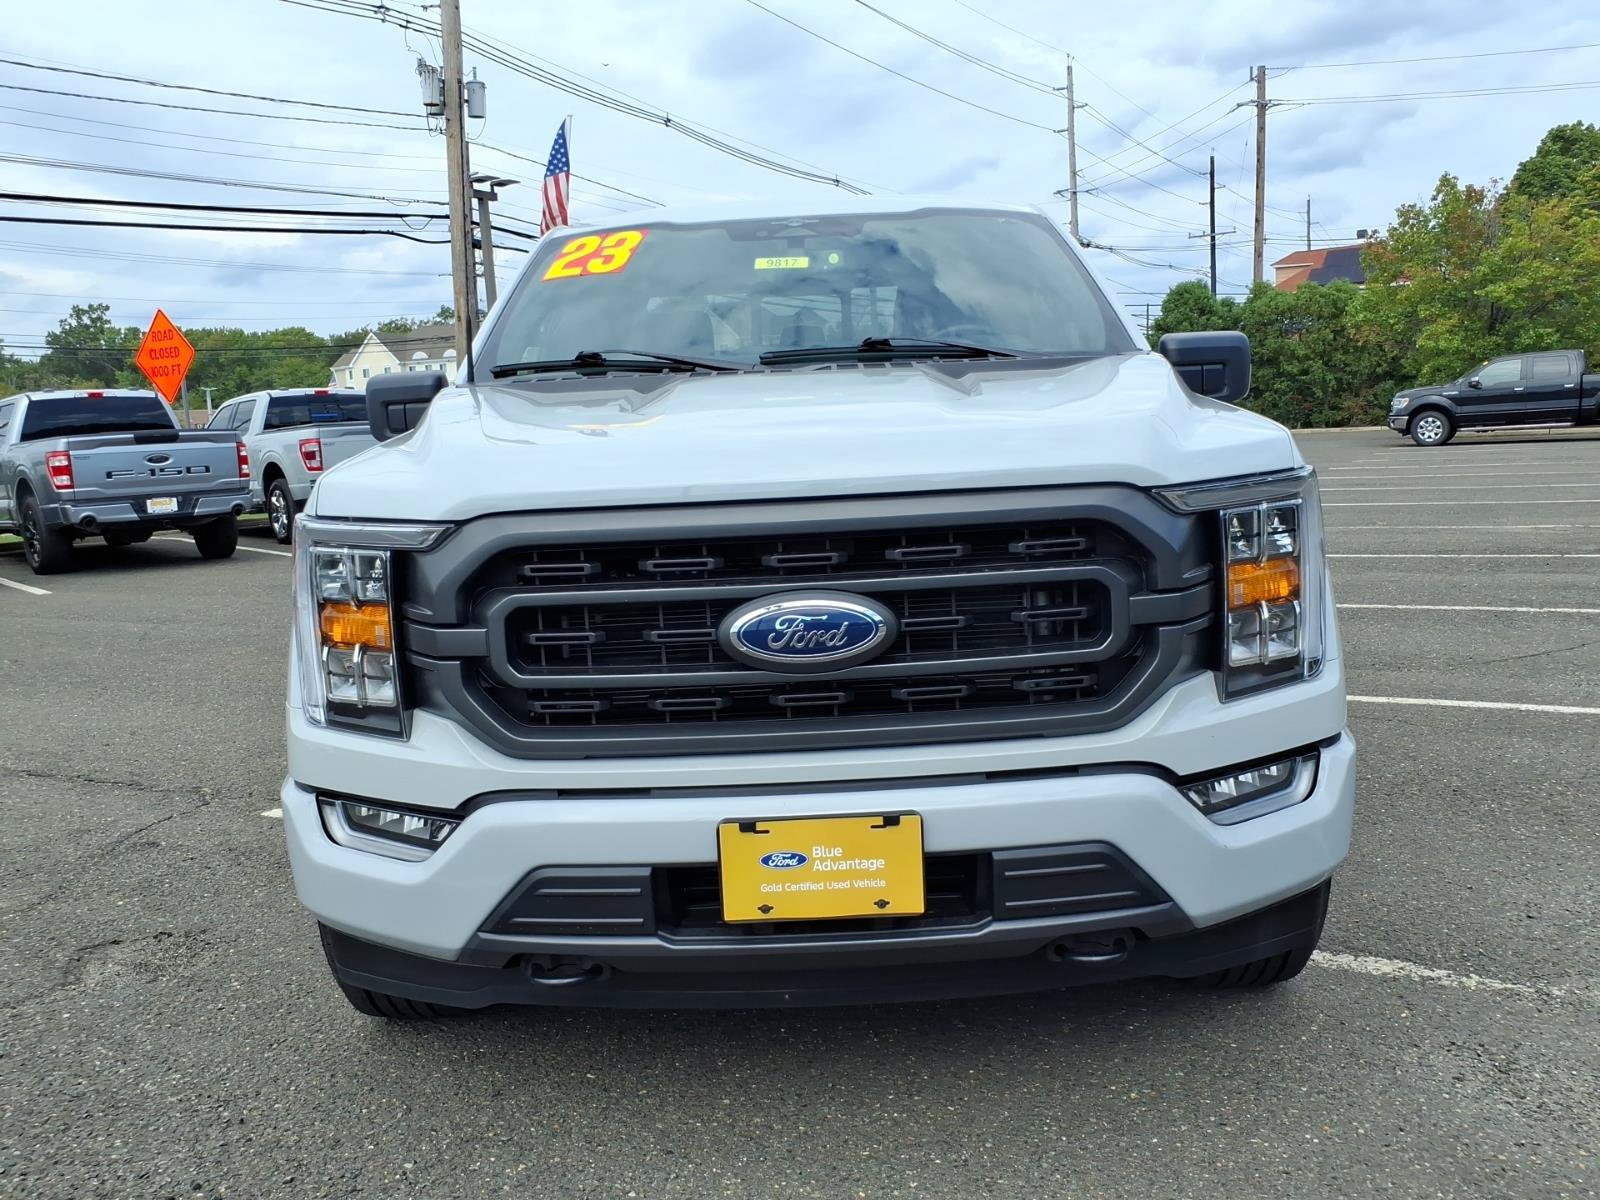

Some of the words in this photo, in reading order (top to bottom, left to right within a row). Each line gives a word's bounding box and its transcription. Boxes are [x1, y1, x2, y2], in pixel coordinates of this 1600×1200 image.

[543, 230, 643, 280] 23
[766, 258, 798, 268] 9817
[151, 329, 174, 342] ROAD
[149, 346, 180, 361] CLOSED
[151, 365, 169, 378] 1000
[171, 363, 182, 376] FT
[105, 465, 212, 481] F-150
[767, 614, 850, 650] Ford
[812, 845, 843, 858] Blue
[768, 853, 800, 867] Ford
[812, 858, 885, 872] Advantage
[760, 883, 783, 893] Gold
[785, 881, 824, 891] Certified
[826, 880, 851, 890] Used
[852, 878, 887, 888] Vehicle
